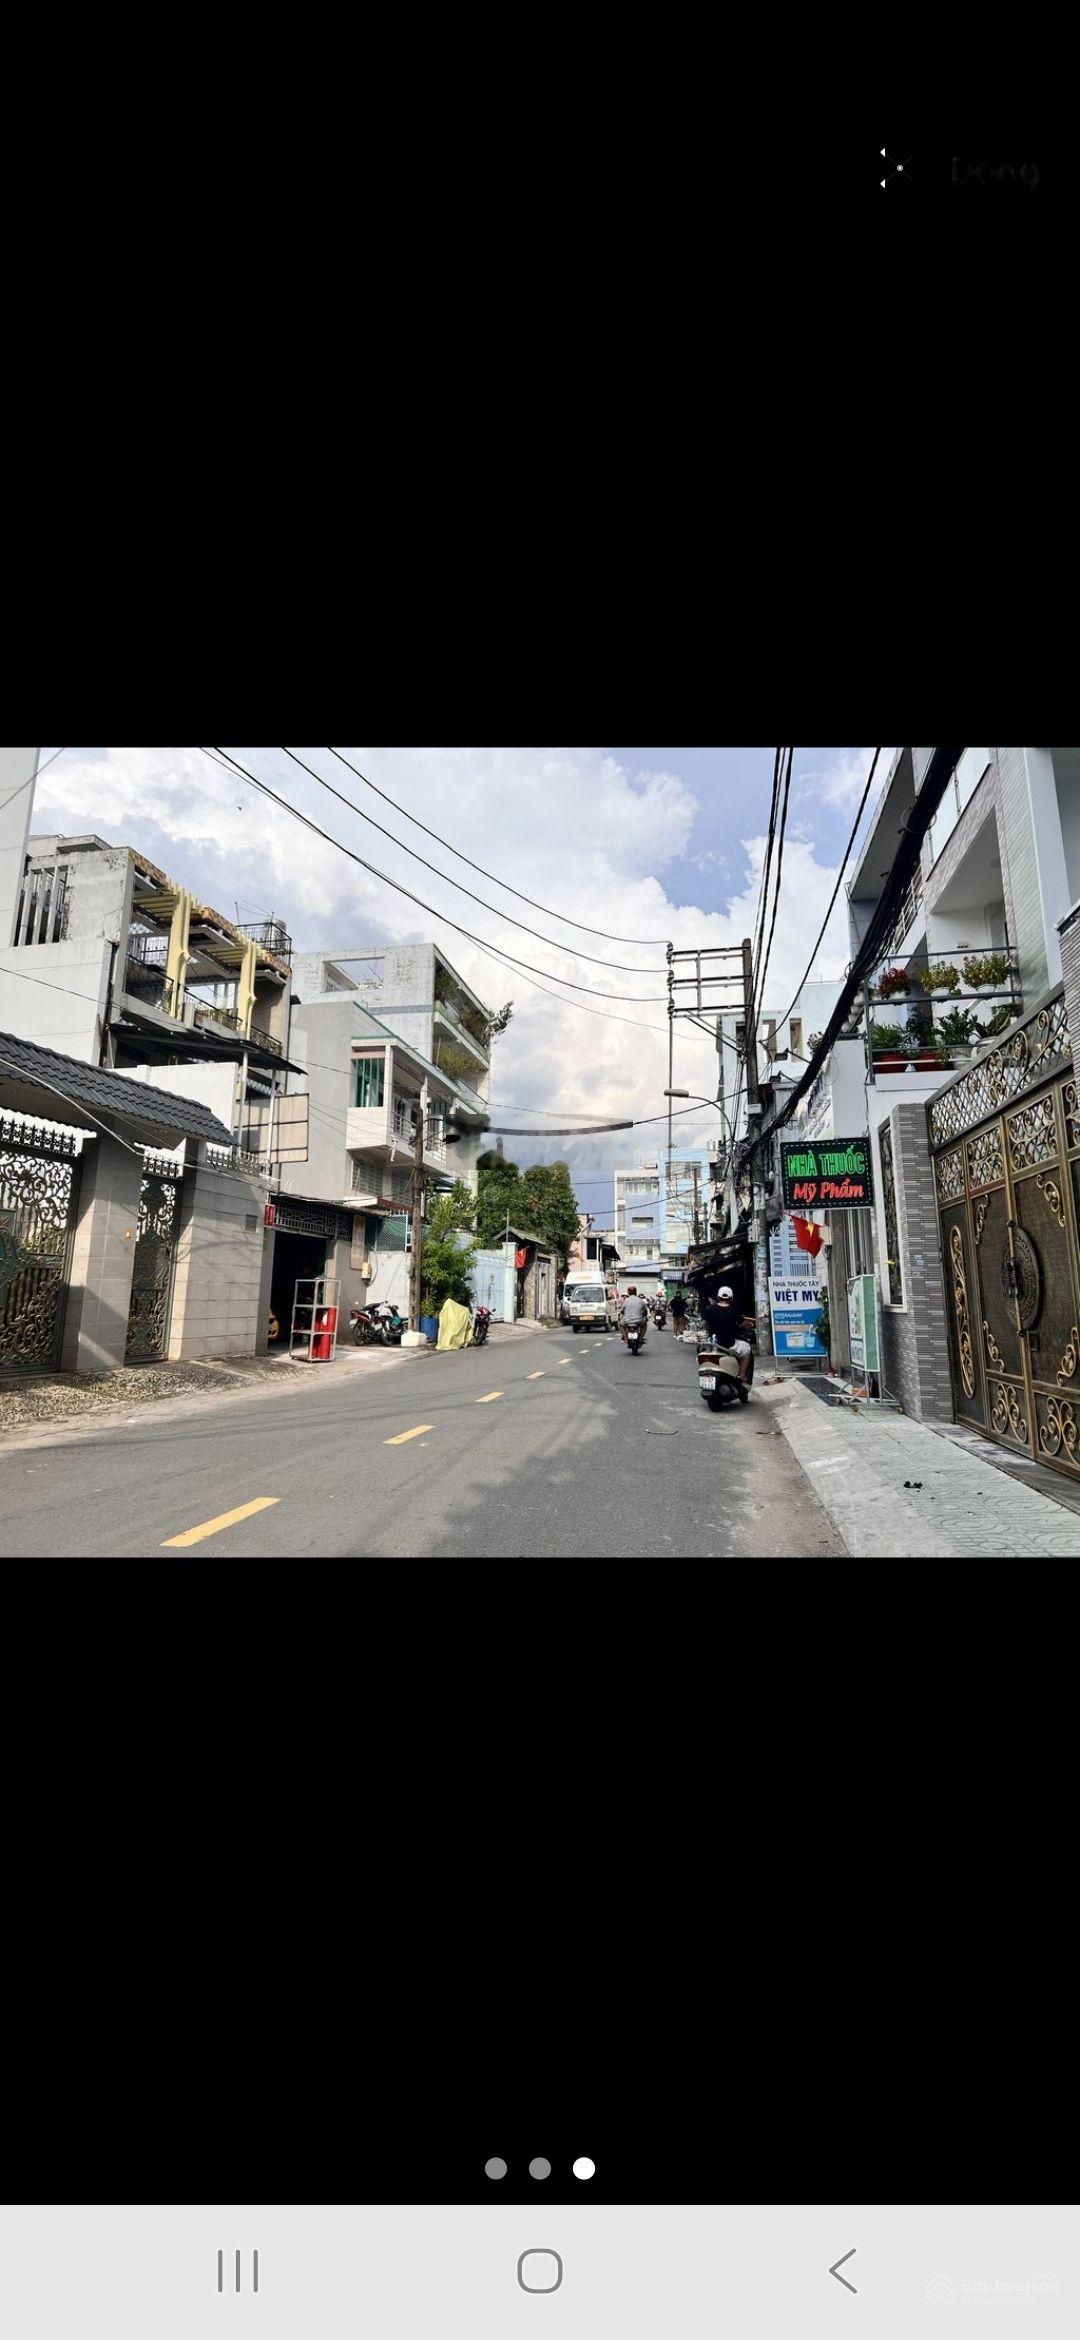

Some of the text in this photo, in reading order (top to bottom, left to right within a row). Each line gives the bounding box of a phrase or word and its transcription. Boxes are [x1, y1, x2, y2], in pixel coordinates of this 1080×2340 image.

[788, 1145, 866, 1177] NHÀ THUỐC
[793, 1178, 865, 1203] Mỹ Phẩm
[774, 1288, 799, 1304] VIỆT
